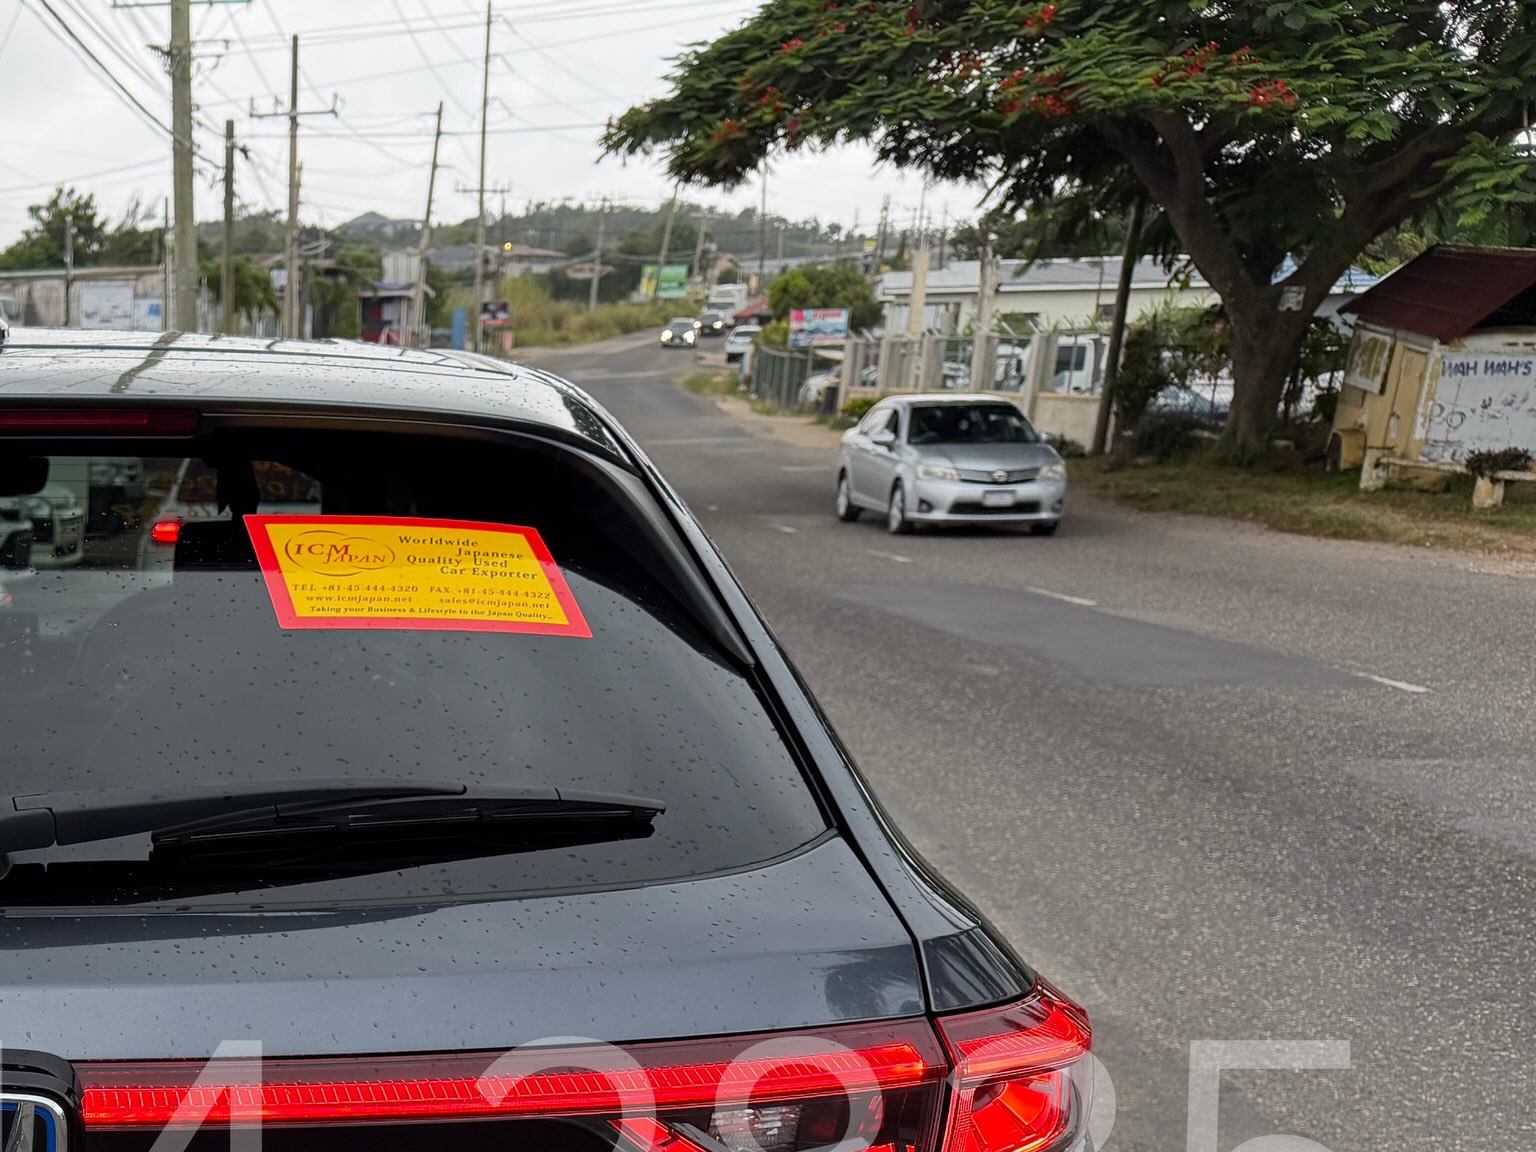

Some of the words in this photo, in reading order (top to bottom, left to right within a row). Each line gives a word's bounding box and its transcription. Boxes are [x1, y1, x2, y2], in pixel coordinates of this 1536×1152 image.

[398, 535, 479, 547] Worldwide
[294, 543, 352, 556] ICM
[323, 548, 386, 564] JAPAN
[455, 547, 524, 560] Japanese
[406, 554, 463, 567] Quality
[473, 558, 508, 568] Used
[440, 566, 466, 576] Car
[472, 567, 538, 580] Exporter
[429, 586, 451, 594] FAX
[306, 595, 414, 604] www.icmjapan.net
[439, 597, 550, 610] sales@icmjapan.net
[310, 606, 341, 614] Taking
[418, 607, 457, 616] Lifestyle
[487, 609, 513, 618] Japan
